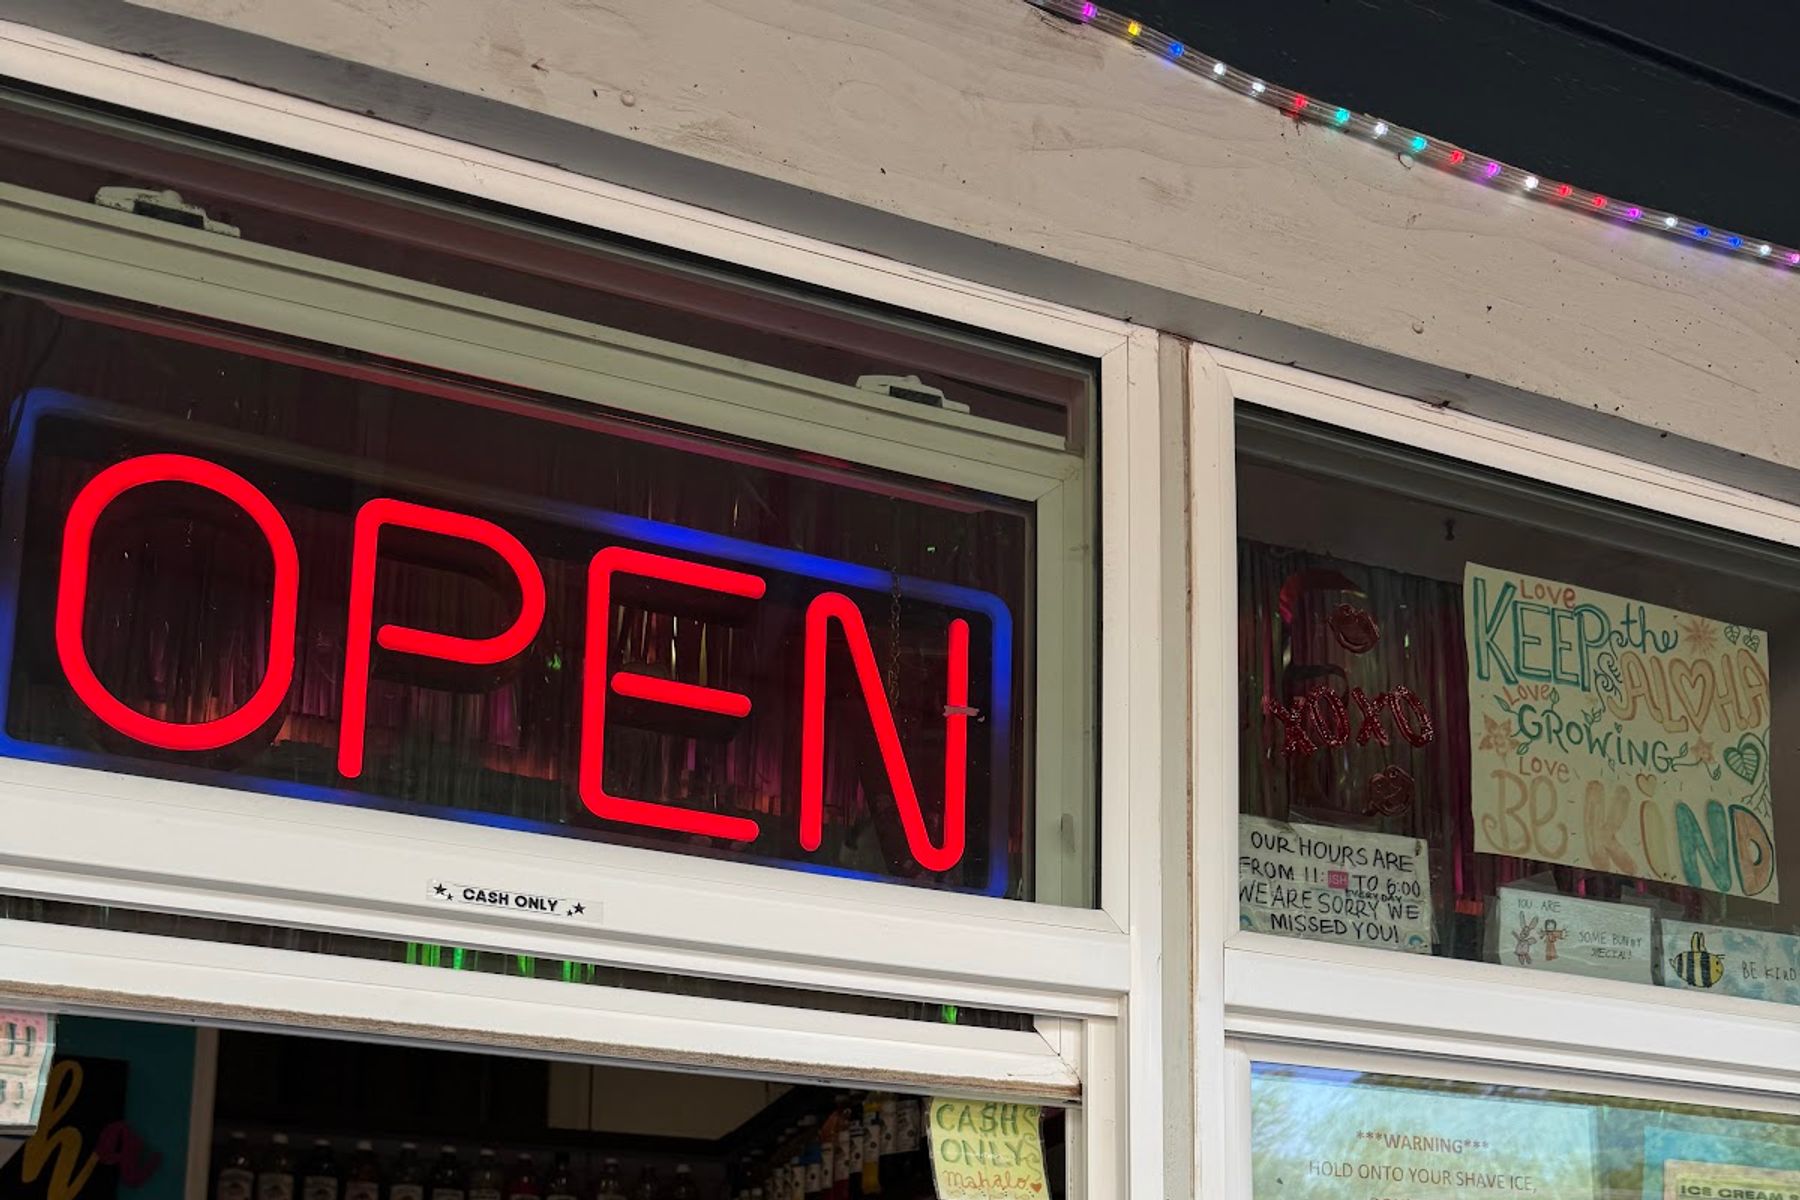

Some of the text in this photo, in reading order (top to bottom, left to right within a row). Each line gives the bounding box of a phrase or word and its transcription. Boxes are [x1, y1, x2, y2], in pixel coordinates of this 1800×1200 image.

[1472, 576, 1678, 692] KEEP the
[55, 452, 970, 873] OPEN
[1251, 831, 1415, 873] OUR HOURS ARE
[1239, 856, 1294, 881] FROM
[1352, 874, 1379, 892] TO
[463, 888, 558, 912] CASH ONLY
[1239, 880, 1419, 920] WE ARE SORRY WE
[1541, 900, 1561, 913] ARE
[1270, 913, 1400, 944] MISSED YOU!
[1579, 931, 1607, 945] SOME
[1742, 961, 1759, 980] BE
[936, 1101, 1019, 1136] CASH
[940, 1138, 1024, 1167] ONLY
[1309, 1160, 1538, 1194] HOLD ONTO YOUR SHAVE ICE,
[1681, 1185, 1712, 1197] ICE
